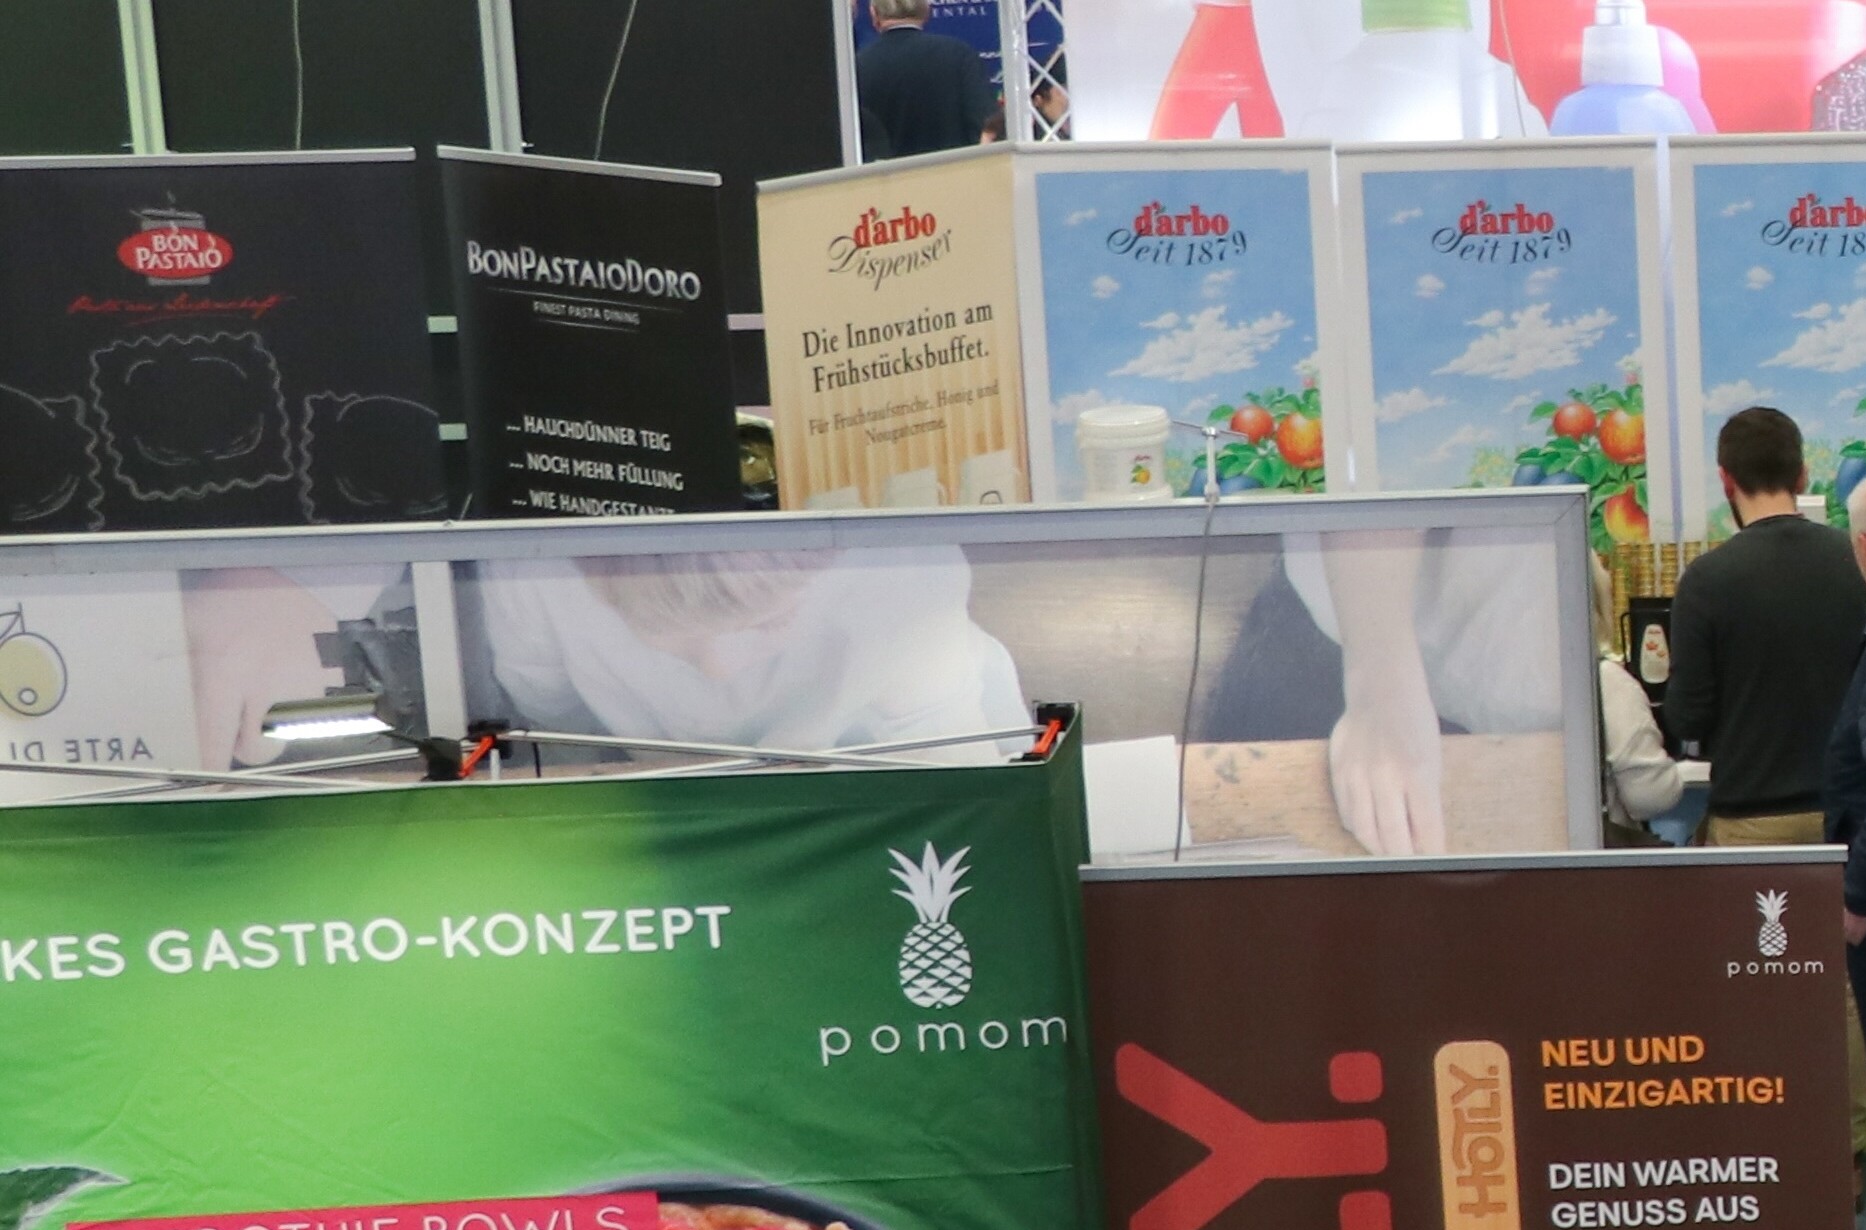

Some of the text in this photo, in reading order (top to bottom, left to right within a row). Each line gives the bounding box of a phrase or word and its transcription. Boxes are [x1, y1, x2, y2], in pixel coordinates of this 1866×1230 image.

[932, 5, 987, 17] ENTAL
[152, 233, 198, 252] BON
[1107, 228, 1248, 267] Seit 1879
[1431, 226, 1573, 265] Seit 1879
[1761, 218, 1830, 259] Seit
[828, 228, 954, 291] Dispenser
[568, 304, 601, 319] PASTA
[603, 309, 640, 325] DINING
[802, 303, 994, 359] Die Innovation am
[813, 334, 989, 393] Frühstücksbuffet.
[524, 414, 637, 447] HAUCHDÜNNER
[640, 430, 671, 451] TEIG
[526, 453, 570, 475] NOCH
[573, 458, 614, 481] MEHR
[618, 462, 684, 490] FÜLLUNG
[529, 489, 556, 509] WIE
[2, 905, 732, 982] KES GASTRO-KONZEPT
[1726, 958, 1825, 977] pomom
[818, 1011, 1068, 1067] pomom
[1541, 1035, 1705, 1068] NEU UND
[1544, 1076, 1785, 1111] EINZIGARTIG!
[1549, 1156, 1780, 1190] DEIN WARMER
[1551, 1195, 1760, 1229] GENUSS AUS
